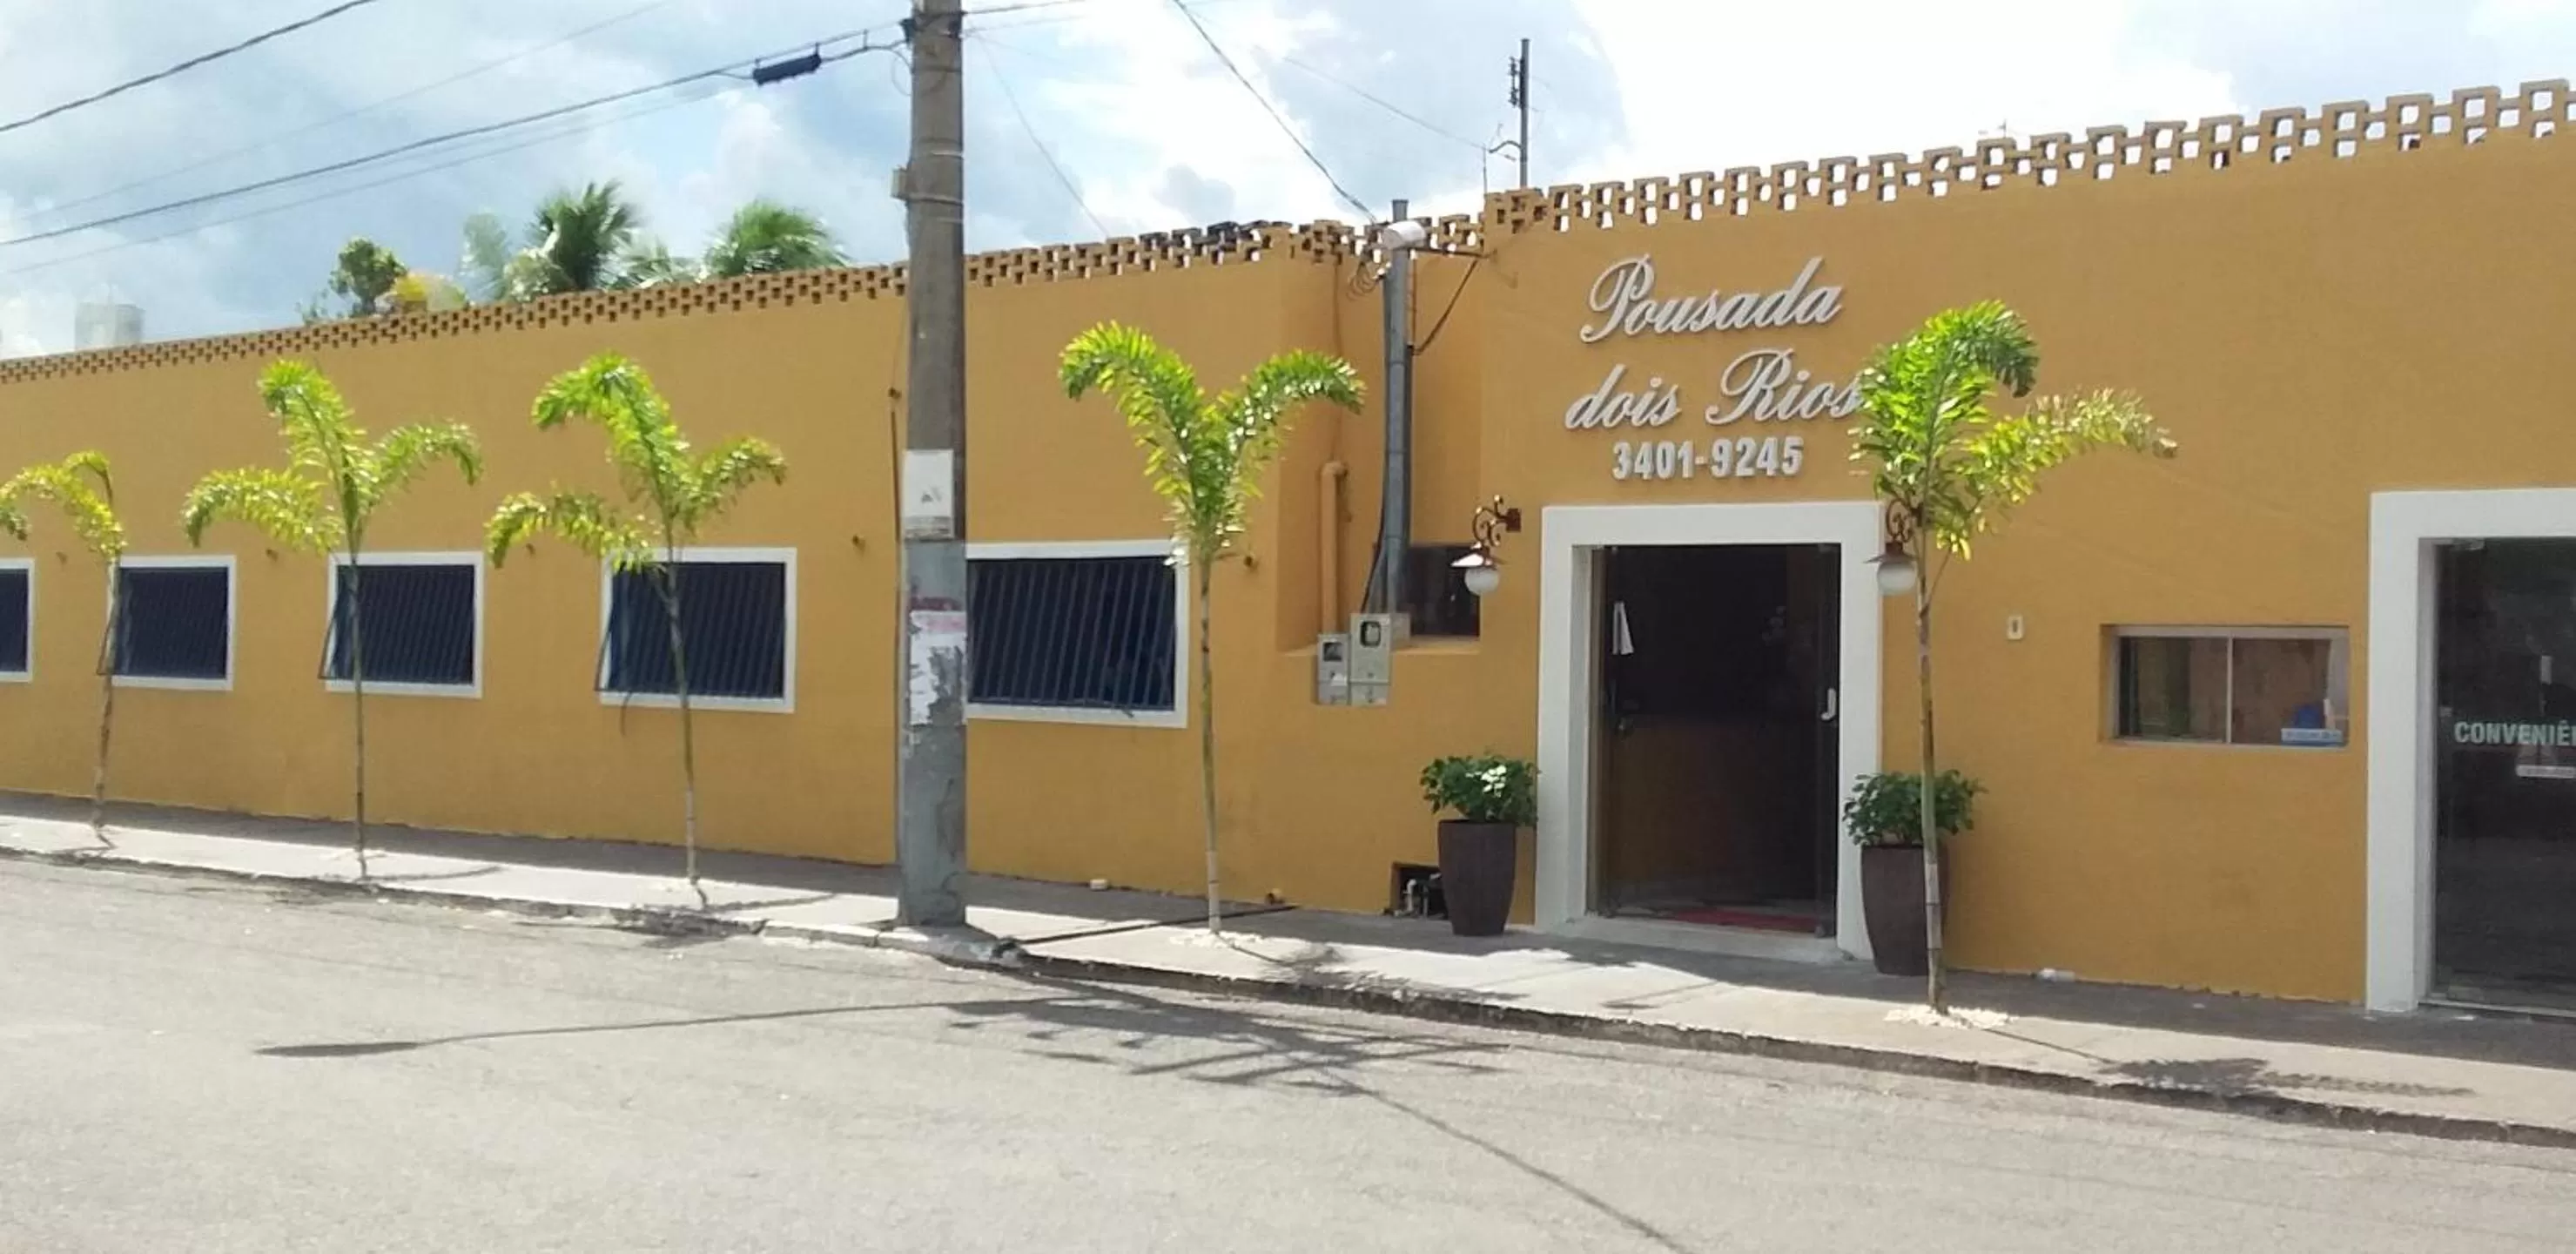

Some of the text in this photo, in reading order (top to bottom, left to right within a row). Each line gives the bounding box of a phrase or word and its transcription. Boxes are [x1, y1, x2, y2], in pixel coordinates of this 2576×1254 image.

[1579, 253, 1845, 343] Pousada
[1564, 347, 1864, 428] dois Rios
[1611, 435, 1805, 480] 3401-9245
